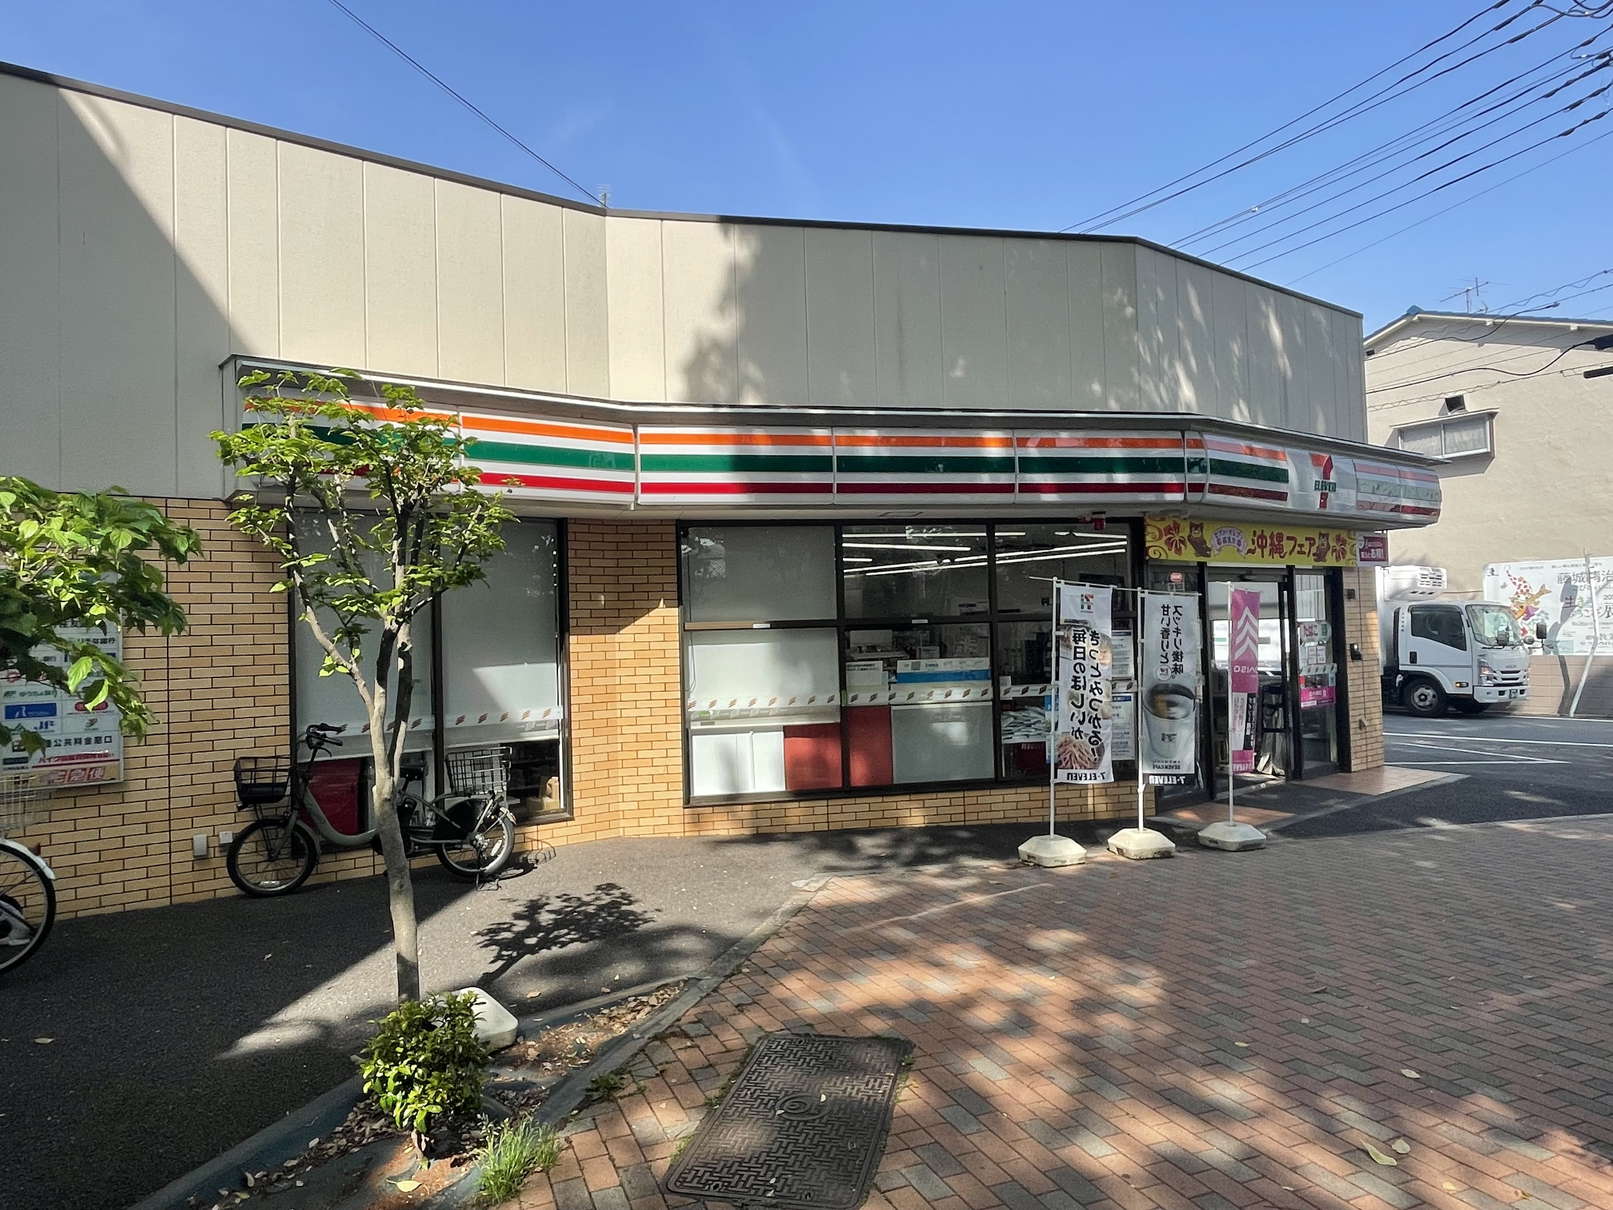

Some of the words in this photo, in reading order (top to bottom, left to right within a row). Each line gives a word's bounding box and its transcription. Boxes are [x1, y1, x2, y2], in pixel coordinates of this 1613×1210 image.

[1247, 529, 1316, 559] 沖縄フェア
